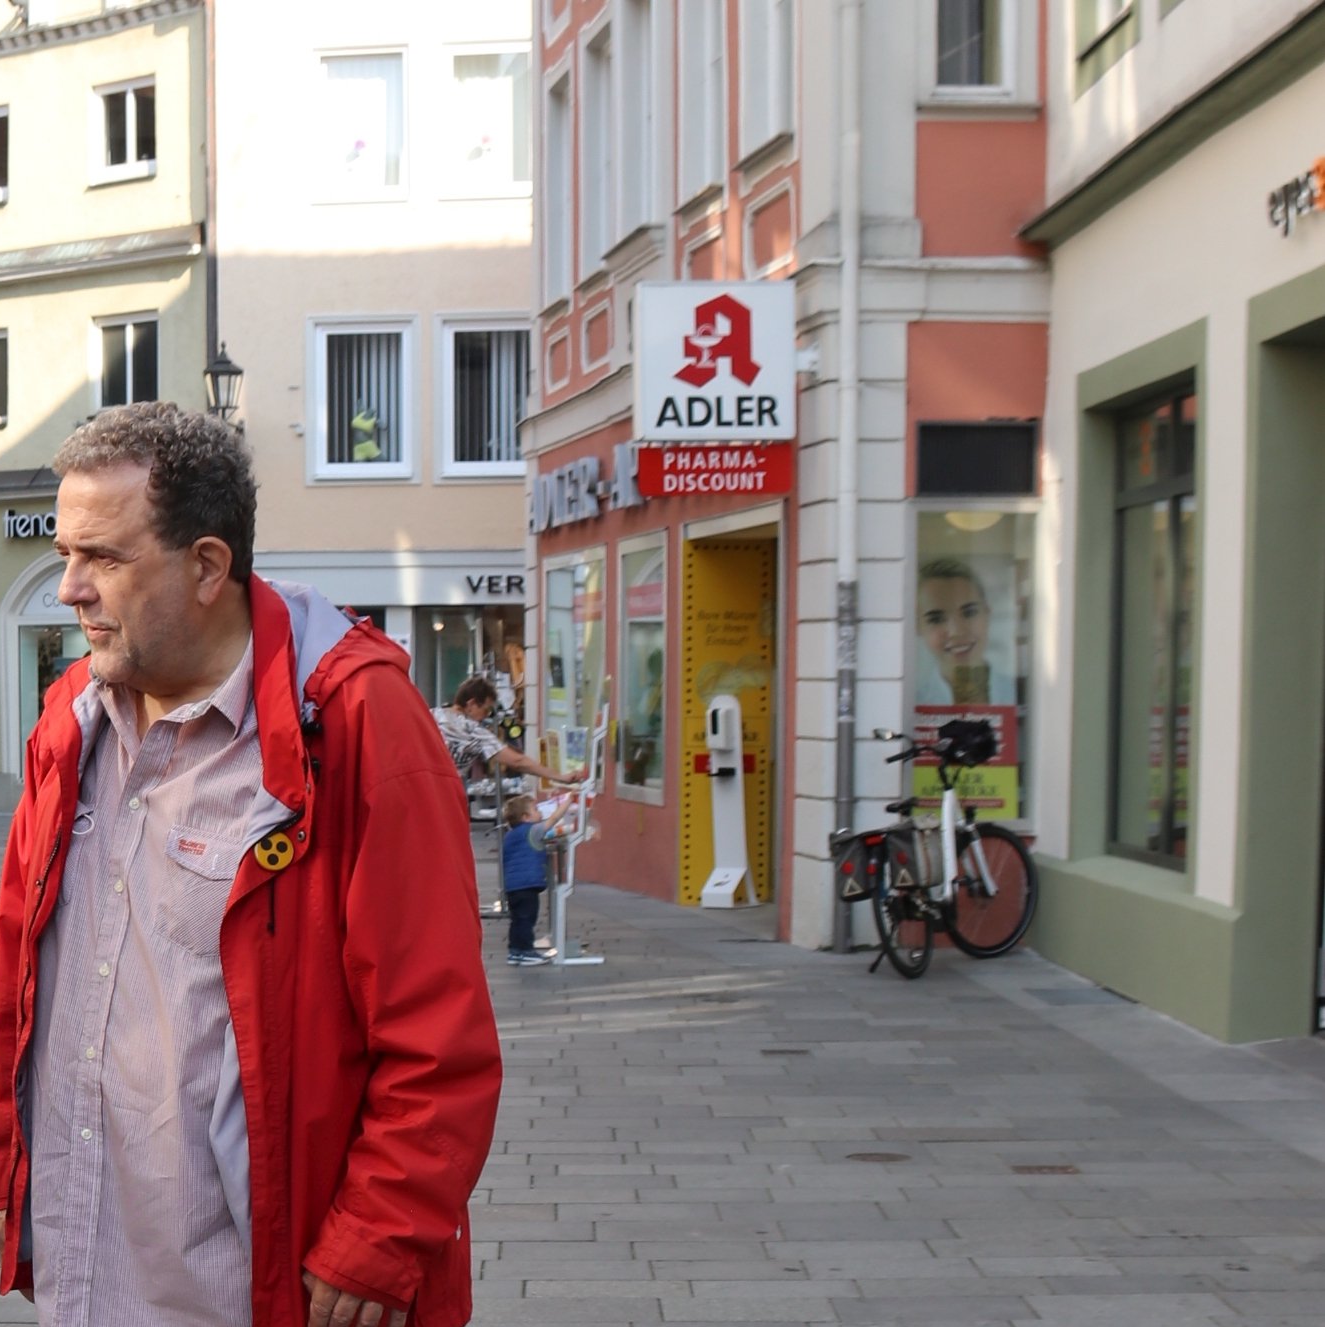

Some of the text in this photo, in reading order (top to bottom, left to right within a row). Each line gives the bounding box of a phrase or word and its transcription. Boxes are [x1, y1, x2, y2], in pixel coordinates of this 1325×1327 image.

[656, 396, 779, 427] ADLER
[663, 451, 766, 470] PHARMA-
[663, 472, 767, 492] DISCOUNT
[466, 575, 525, 594] VER
[42, 592, 64, 608] Co
